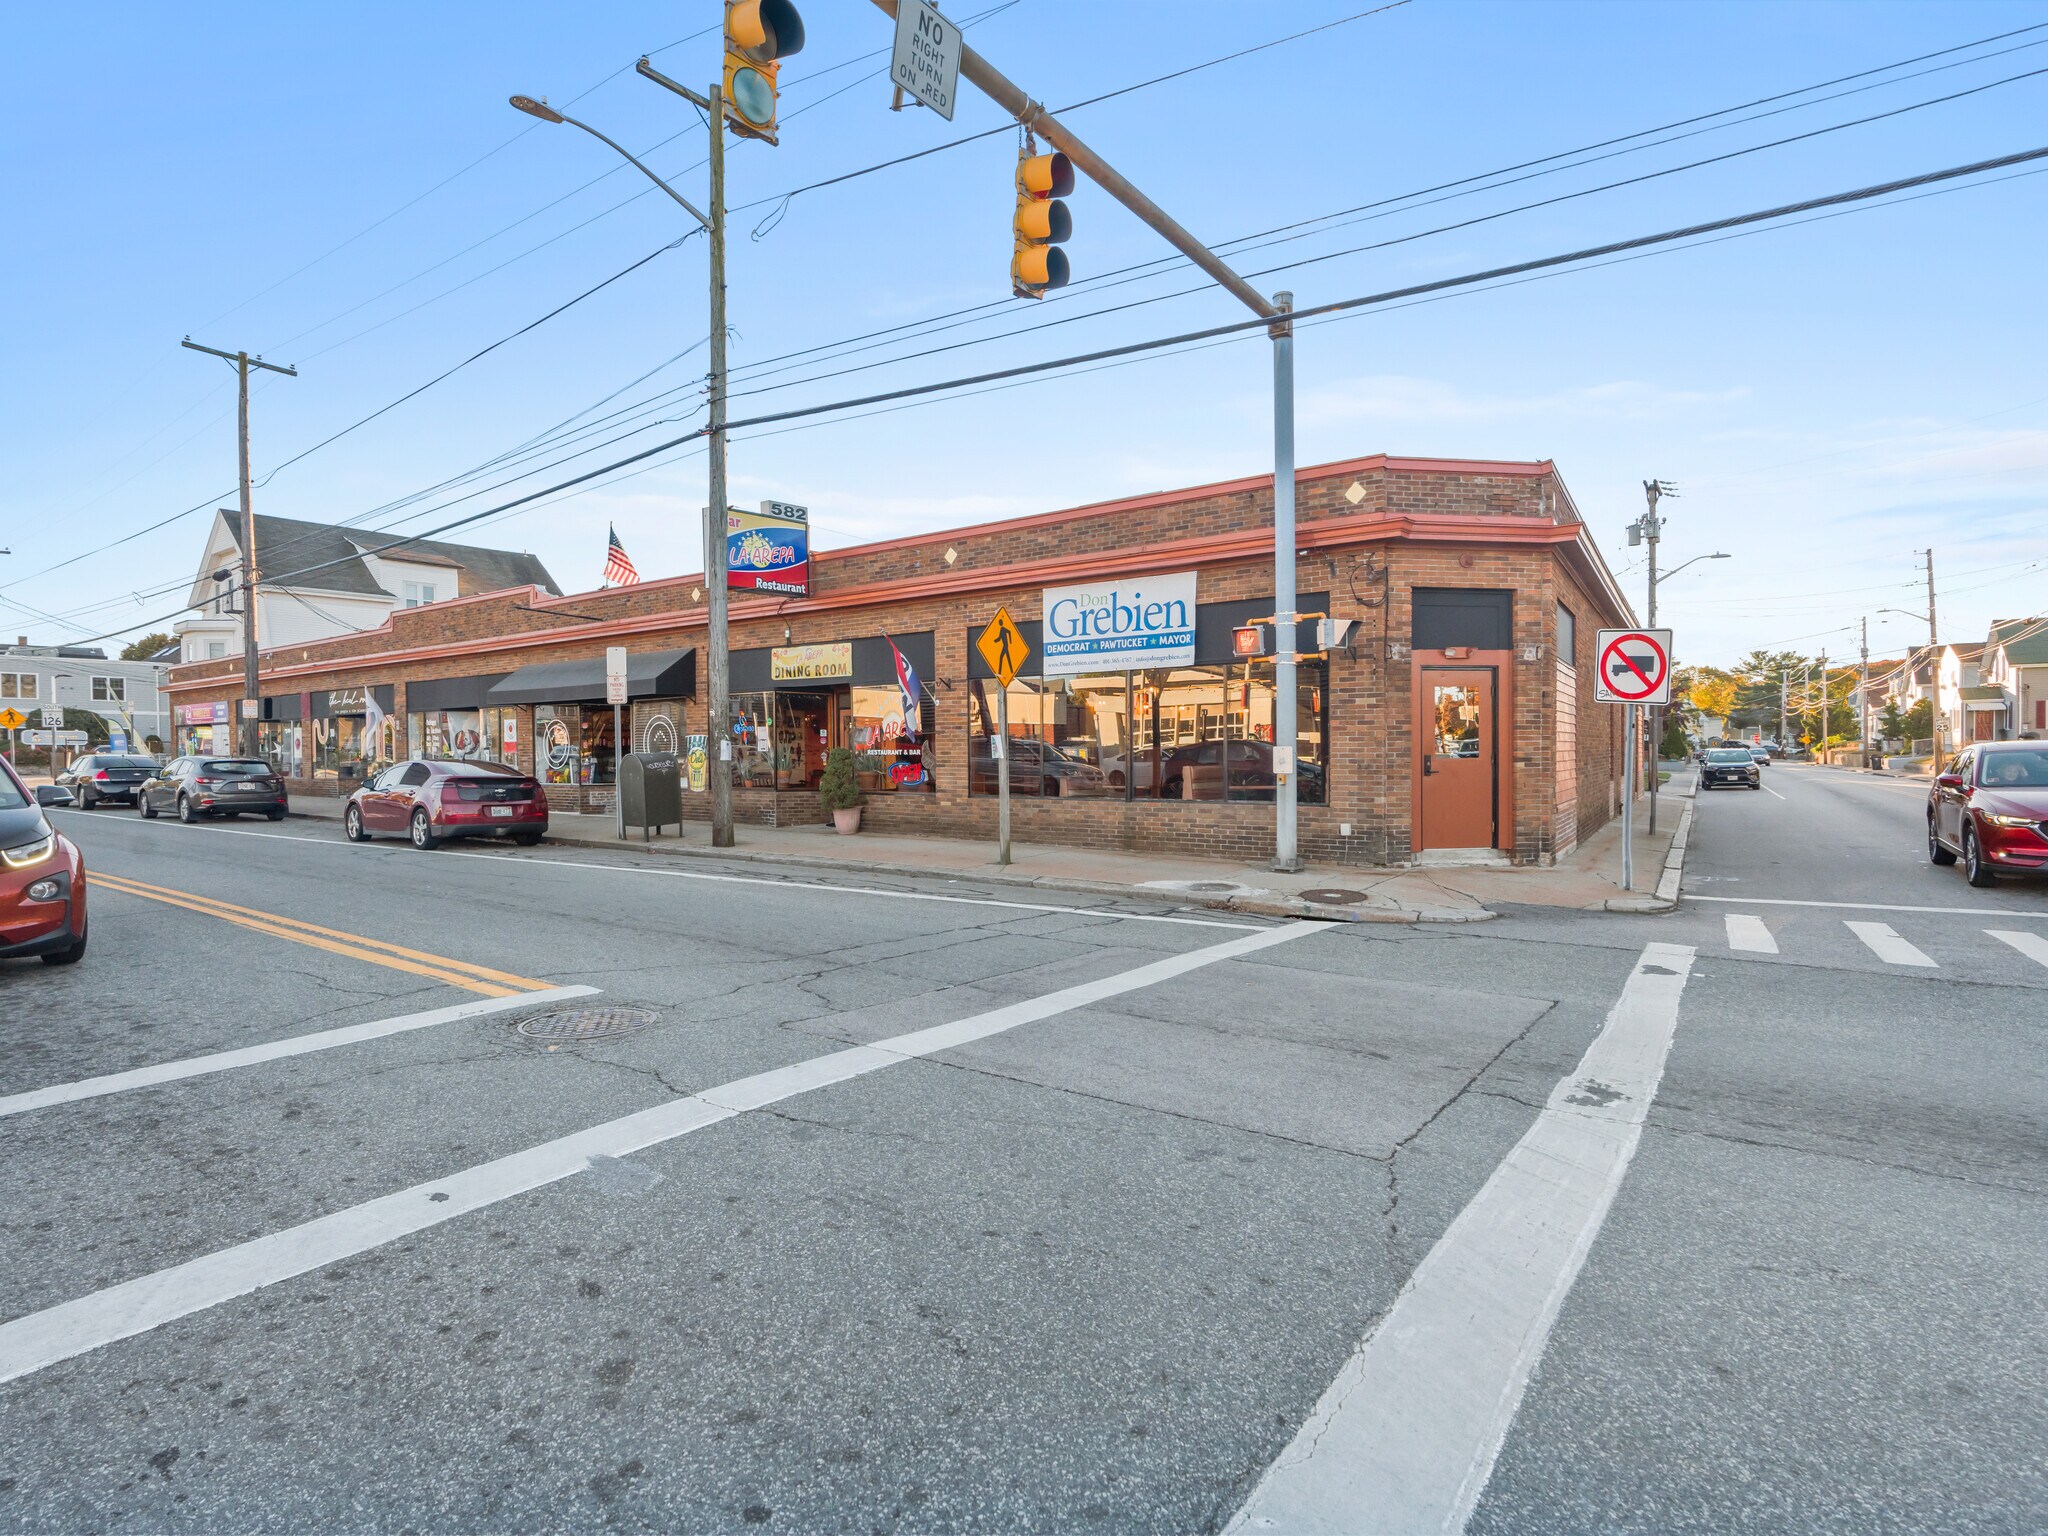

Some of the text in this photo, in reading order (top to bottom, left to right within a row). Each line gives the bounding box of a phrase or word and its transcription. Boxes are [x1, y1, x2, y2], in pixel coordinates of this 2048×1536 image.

[919, 10, 943, 45] NO
[912, 33, 945, 68] RIGHT
[912, 51, 942, 86] TURN
[900, 64, 947, 107] ON RED
[728, 517, 741, 527] ar
[771, 504, 807, 520] 582
[729, 546, 795, 566] LA AREPA
[755, 577, 806, 593] Restaurant
[1080, 594, 1109, 608] Don
[1049, 591, 1190, 638] Grebien
[1047, 634, 1191, 654] DEMOCRAT PAWTUCKET MAYOR
[775, 663, 847, 678] DINING ROOM
[43, 717, 62, 726] 126
[866, 725, 880, 746] LA
[892, 763, 922, 783] OPEN
